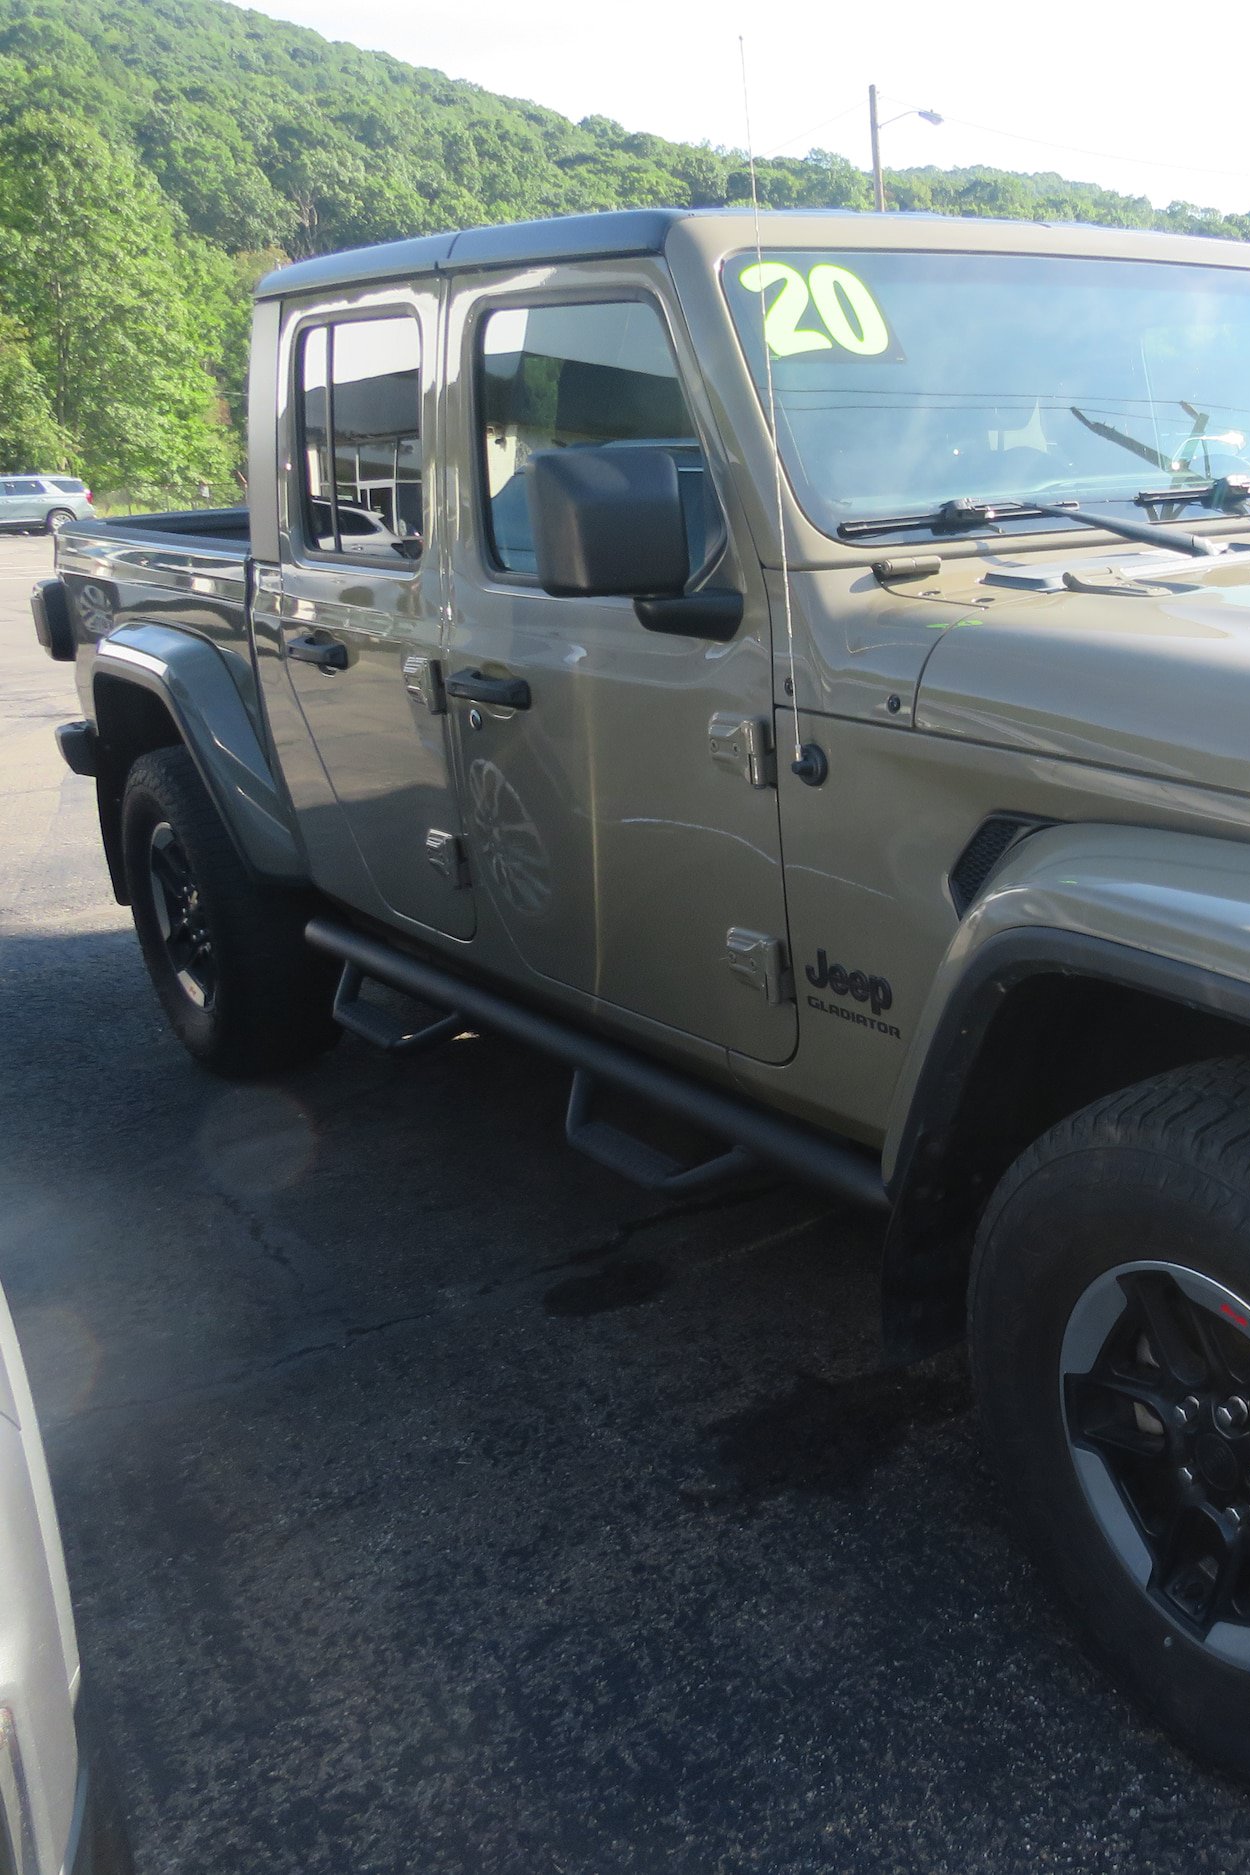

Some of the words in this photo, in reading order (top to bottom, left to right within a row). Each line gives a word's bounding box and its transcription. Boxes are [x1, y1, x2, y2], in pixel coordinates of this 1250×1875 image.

[739, 262, 889, 356] 20
[805, 948, 893, 1016] Jeep
[807, 995, 902, 1039] GLADIATOR
